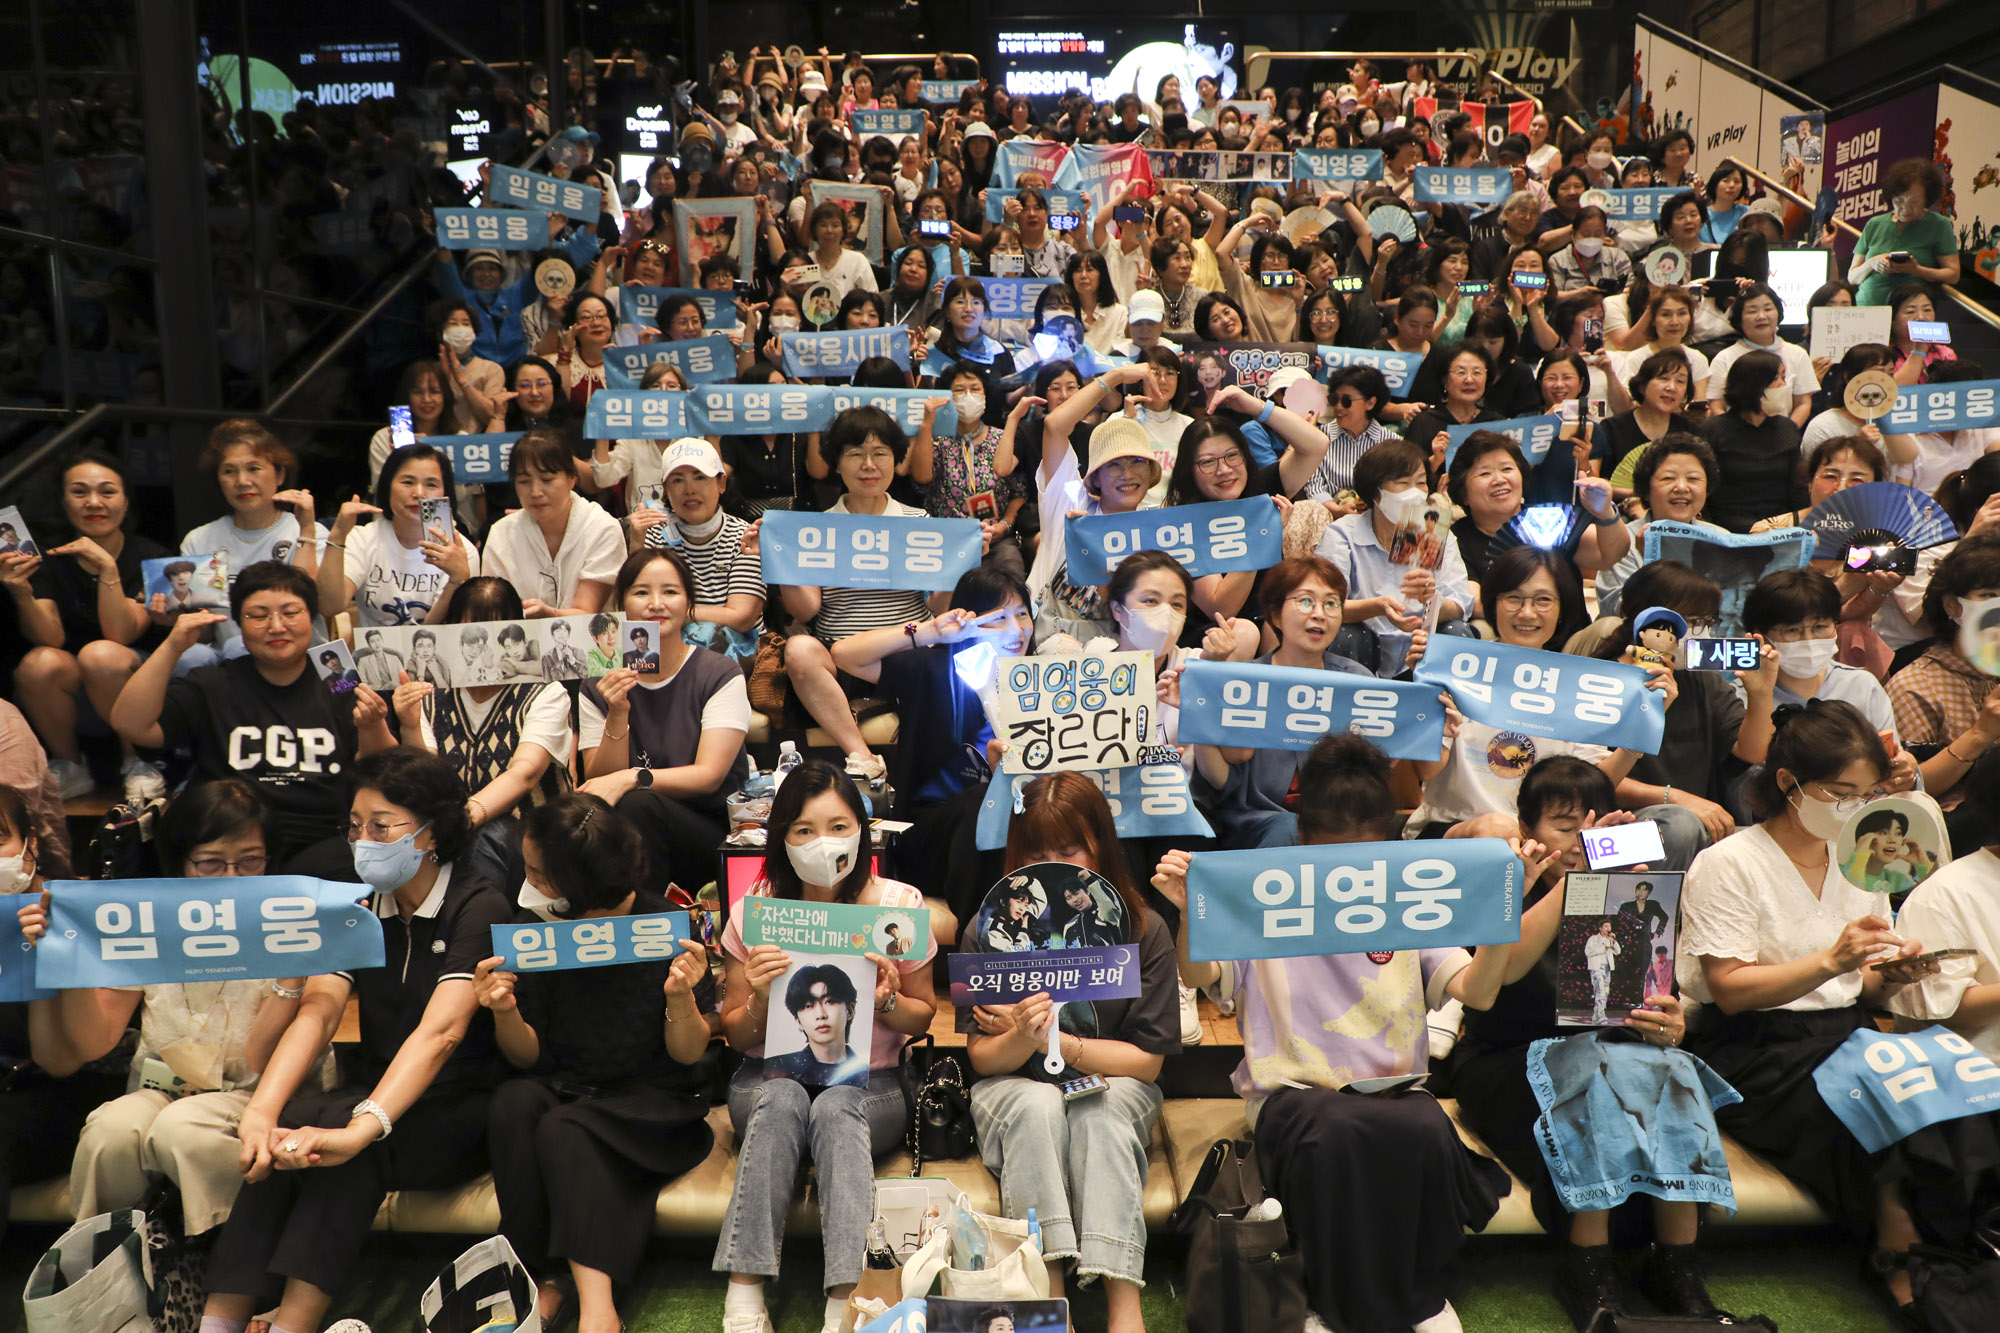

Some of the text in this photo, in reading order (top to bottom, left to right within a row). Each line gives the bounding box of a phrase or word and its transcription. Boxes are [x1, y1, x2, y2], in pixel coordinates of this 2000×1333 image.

[1436, 46, 1581, 89] VR Play
[626, 117, 671, 133] Dream
[863, 114, 912, 129] 임영웅
[1707, 124, 1748, 150] VR Play
[1836, 127, 1881, 166] 놀이의
[1309, 153, 1369, 178] 임영웅
[1834, 159, 1878, 193] 기준이
[509, 173, 584, 211] 임영웅
[1429, 173, 1496, 196] 임영웅
[445, 215, 529, 240] 임영웅
[1332, 277, 1363, 291] 임영웅
[1231, 350, 1308, 371] 영웅아 이제
[706, 391, 808, 422] 임영웅
[1891, 388, 1995, 424] 임영웅
[1813, 519, 1855, 530] HERO
[1826, 513, 1842, 521] IM
[798, 526, 944, 573] 임영웅
[1710, 641, 1760, 668] 사랑
[1009, 657, 1137, 714] 임영웅이
[1450, 652, 1625, 725] 임영웅
[1221, 680, 1399, 738] 임영웅
[228, 725, 341, 775] CGP.
[1148, 745, 1167, 754] IM
[1498, 730, 1513, 742] NOT
[1512, 732, 1537, 755] FOLLOW
[1138, 750, 1182, 764] HERO
[1253, 858, 1462, 938] 임영웅
[1504, 862, 1514, 922] GENERATION
[761, 905, 828, 927] 자신감에
[1197, 893, 1206, 919] HERO
[94, 896, 322, 961] 임영웅
[761, 924, 849, 948] 반했다니까!
[512, 917, 675, 969] 임영웅
[185, 965, 248, 975] HERO GENERATION
[967, 966, 1124, 993] 오직 영웅이만 보여
